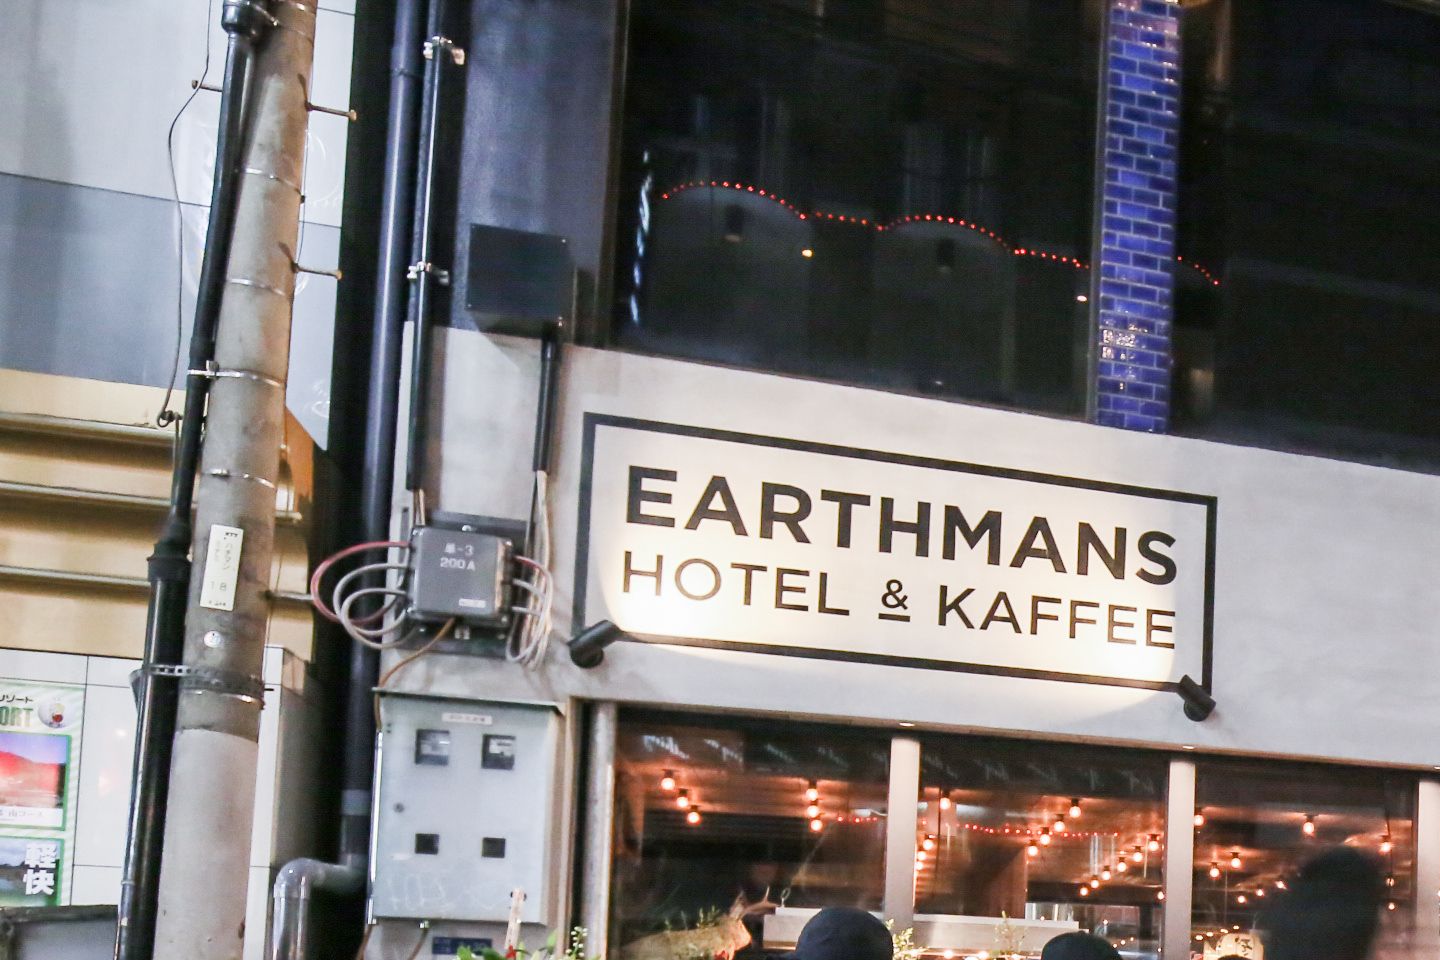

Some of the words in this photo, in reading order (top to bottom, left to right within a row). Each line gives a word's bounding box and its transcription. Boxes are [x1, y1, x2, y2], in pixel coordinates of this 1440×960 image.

[625, 465, 1178, 586] EARTHMANS
[621, 551, 850, 616] HOTEL
[878, 579, 910, 623] &
[937, 585, 1177, 650] KAFFEE
[23, 843, 57, 895] 軽快
